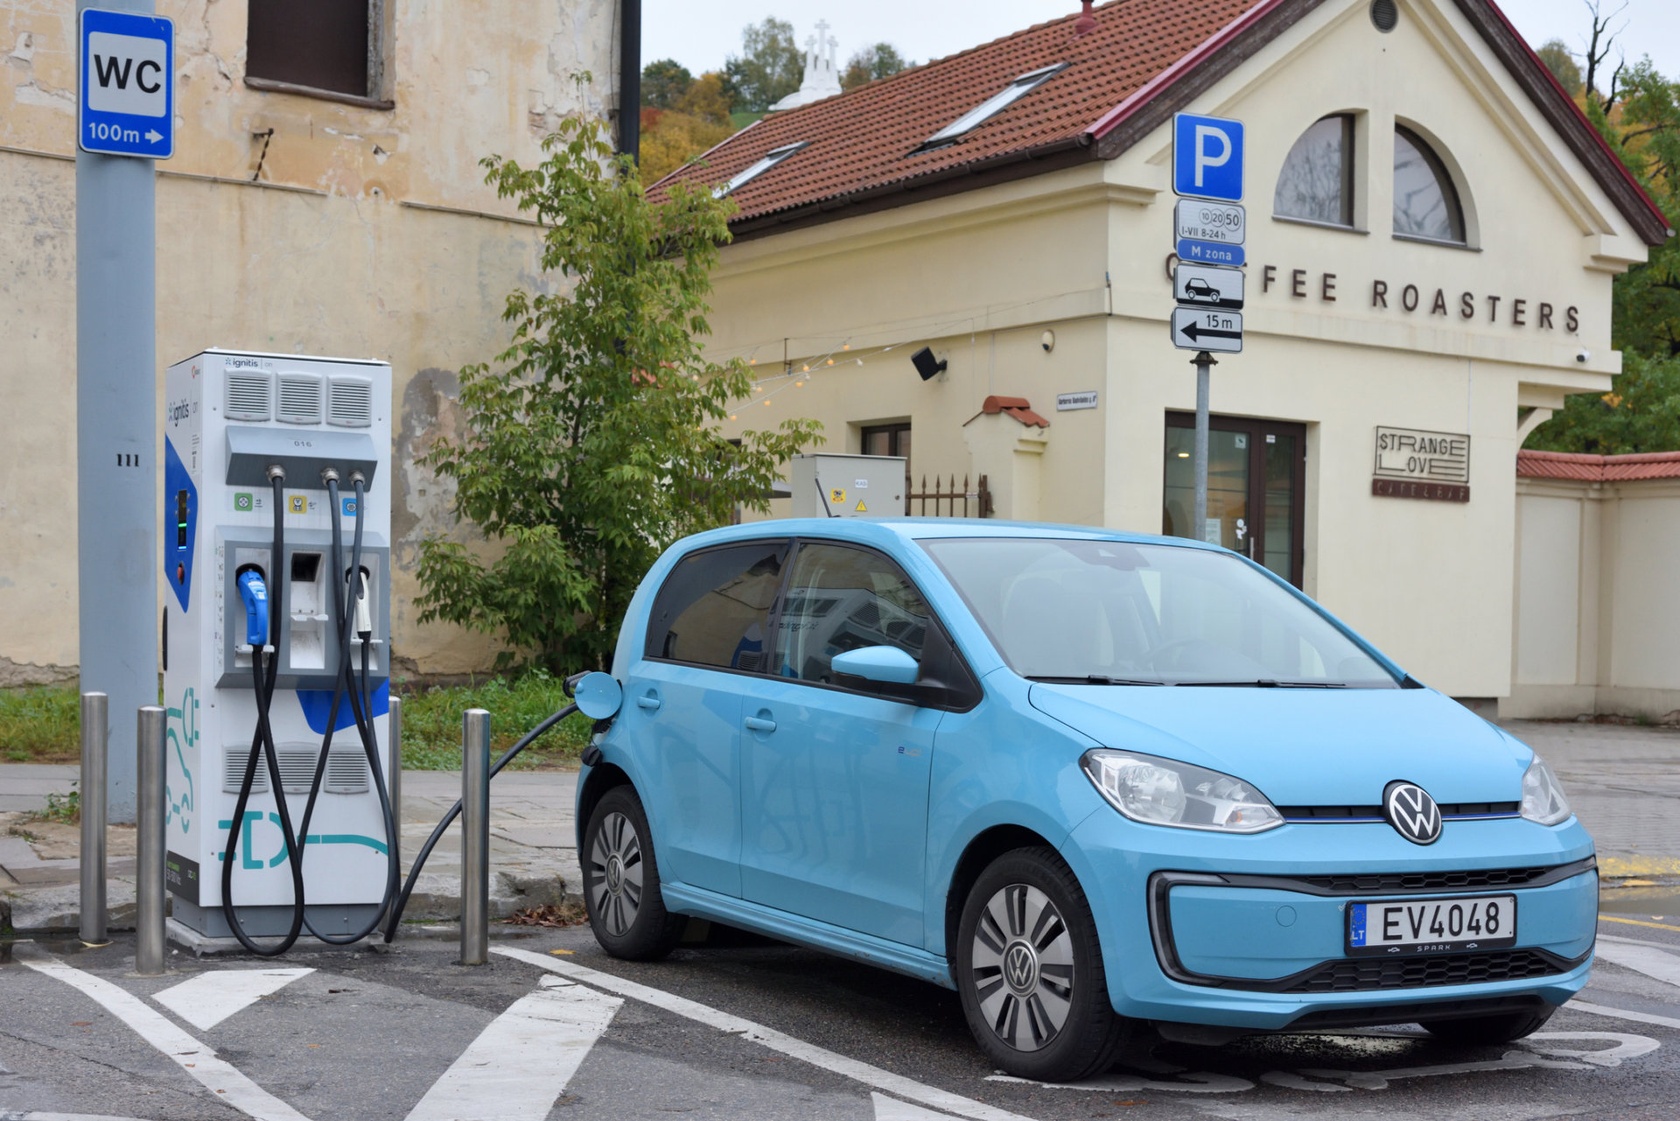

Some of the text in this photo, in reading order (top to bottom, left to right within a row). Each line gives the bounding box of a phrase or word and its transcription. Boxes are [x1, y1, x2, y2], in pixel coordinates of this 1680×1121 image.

[94, 54, 161, 94] WC
[1194, 124, 1232, 188] P
[1212, 213, 1224, 223] 20
[1226, 213, 1240, 226] 50
[1191, 245, 1232, 261] M zona
[1372, 279, 1579, 333] ROASTERS
[232, 357, 259, 368] ignitis
[1379, 433, 1466, 456] STRANGE
[1378, 453, 1466, 477] LOVE
[1383, 902, 1500, 941] EV4048
[1351, 930, 1365, 940] LT
